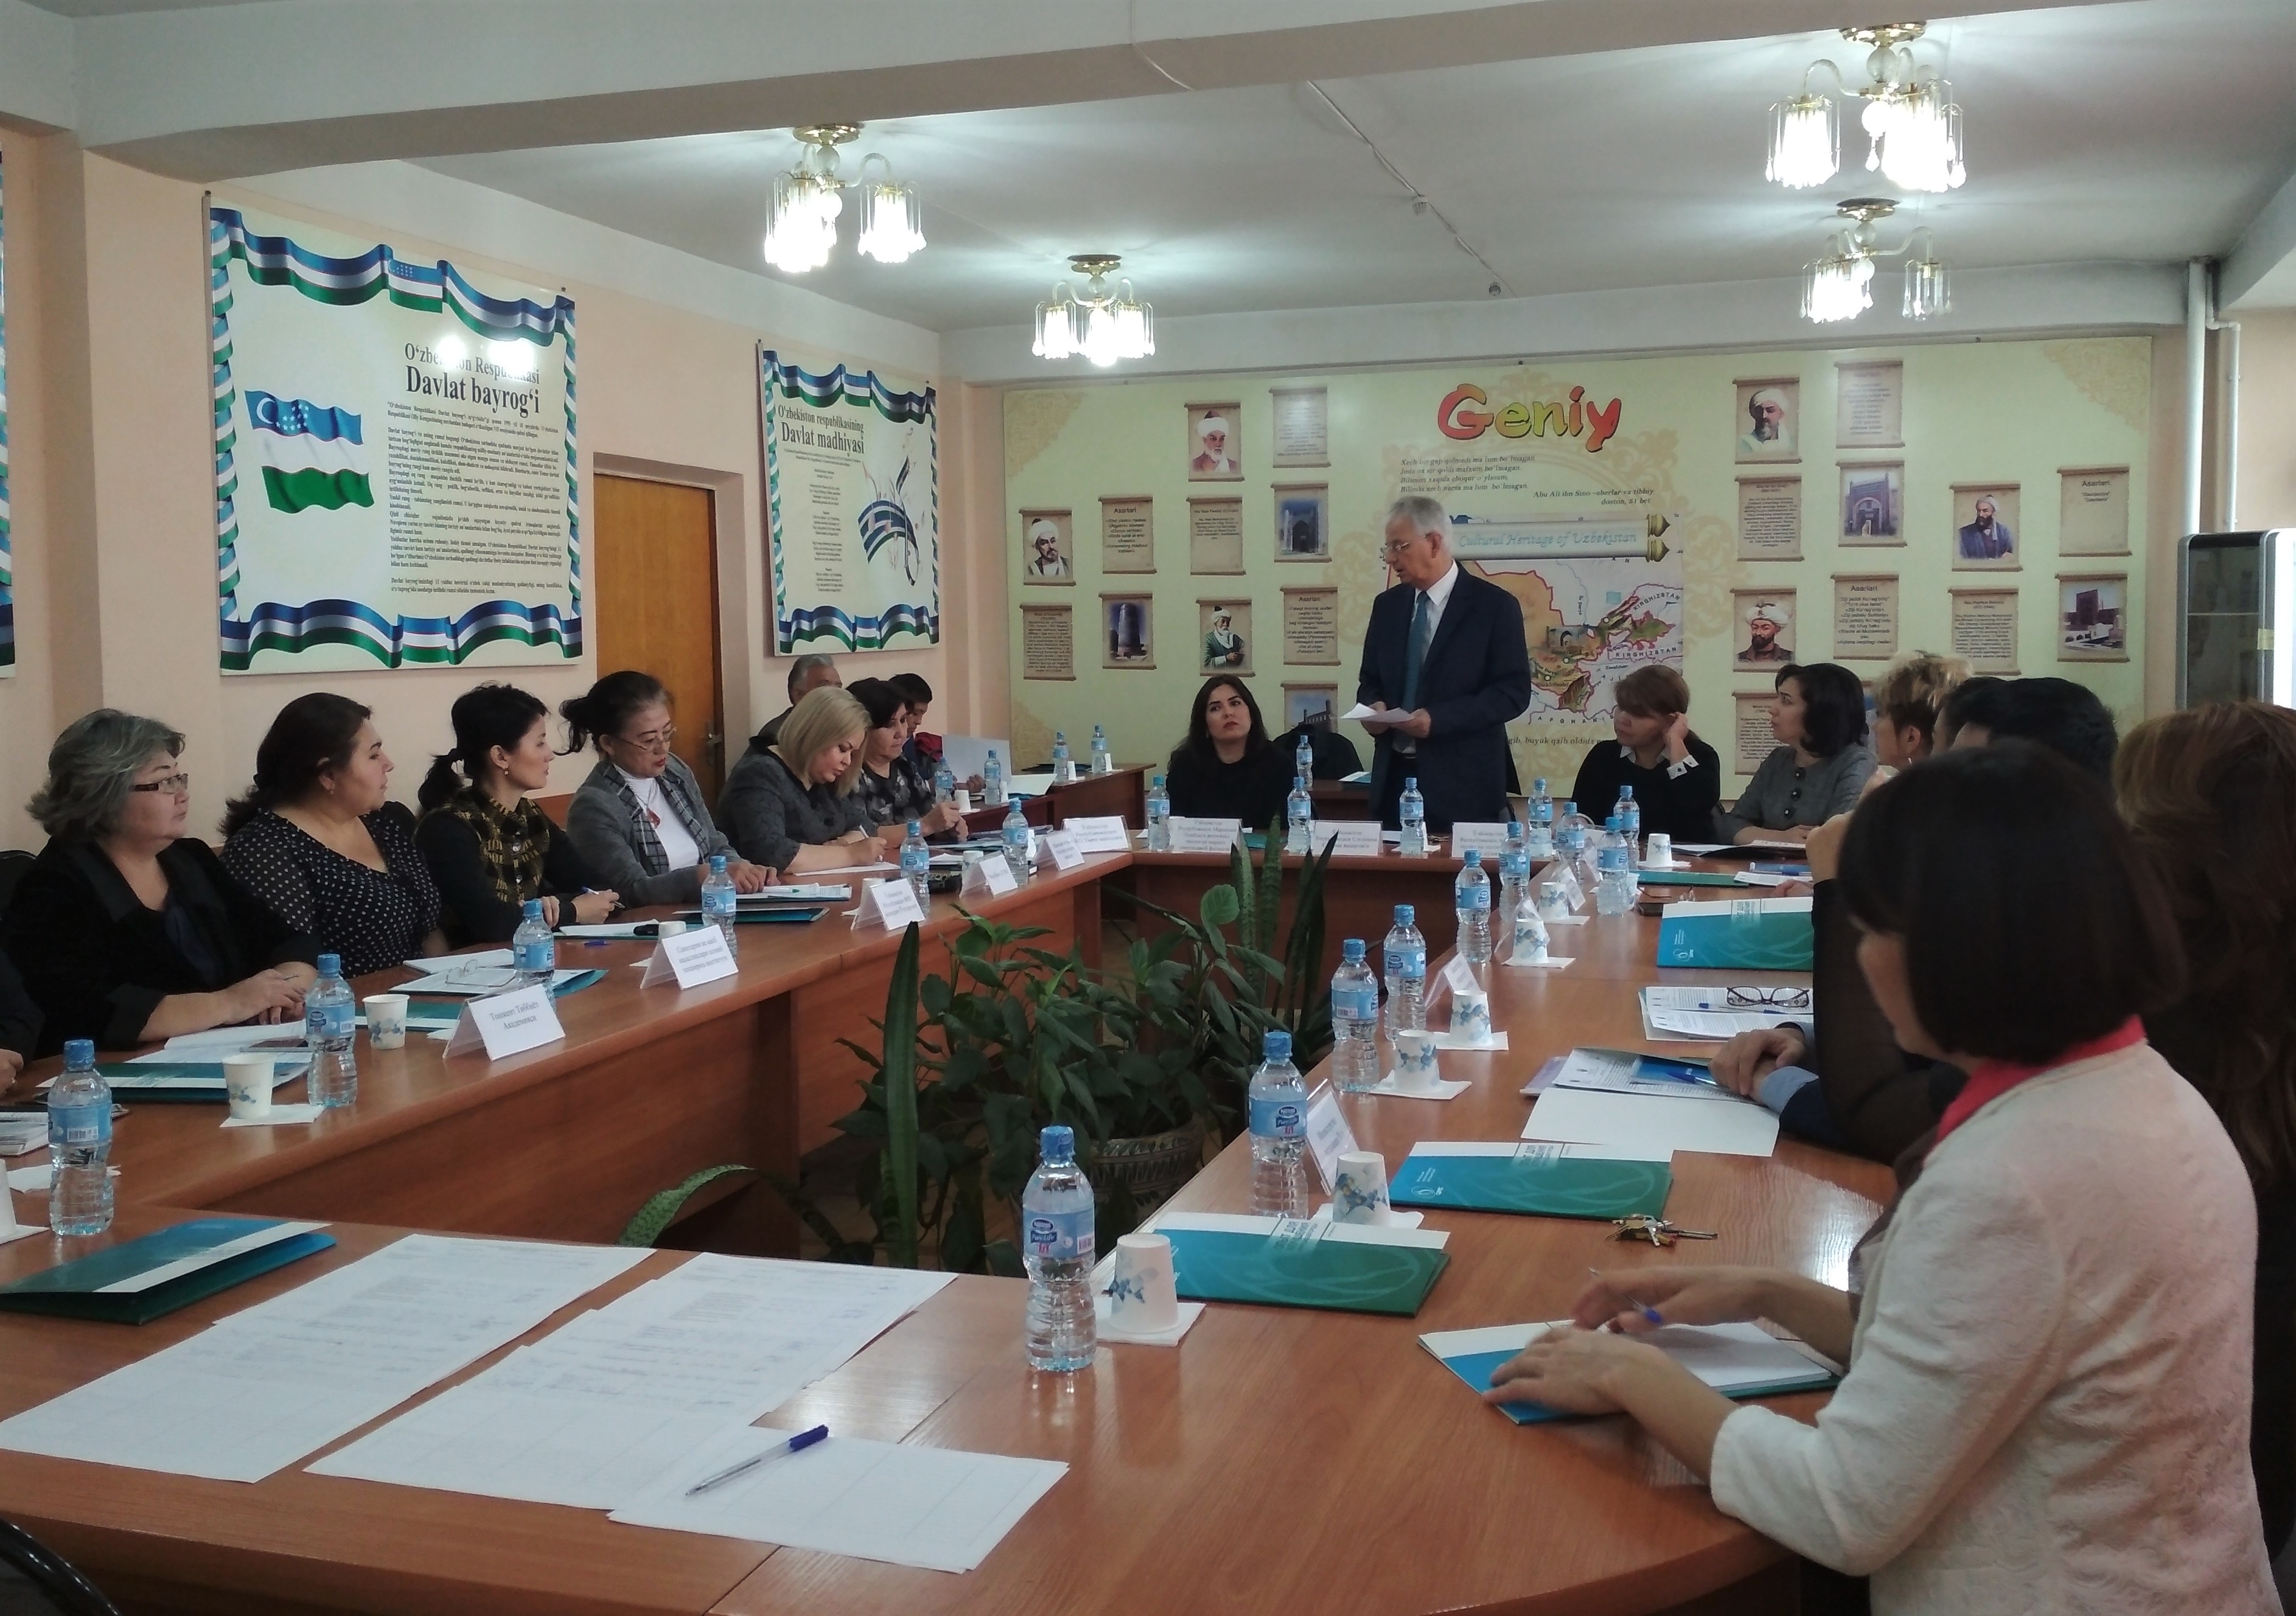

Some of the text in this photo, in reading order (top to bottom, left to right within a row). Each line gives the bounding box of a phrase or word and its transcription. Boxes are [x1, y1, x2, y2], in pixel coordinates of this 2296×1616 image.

[405, 365, 466, 401] Davlat
[817, 415, 864, 434] respublikasining
[1437, 383, 1621, 453] Geniy
[781, 422, 864, 457] Davlat madhiyasi
[1460, 530, 1637, 548] Cultural Heritage of Uzbekistan
[1526, 737, 1548, 746] buyuk
[1551, 737, 1568, 746] qalb
